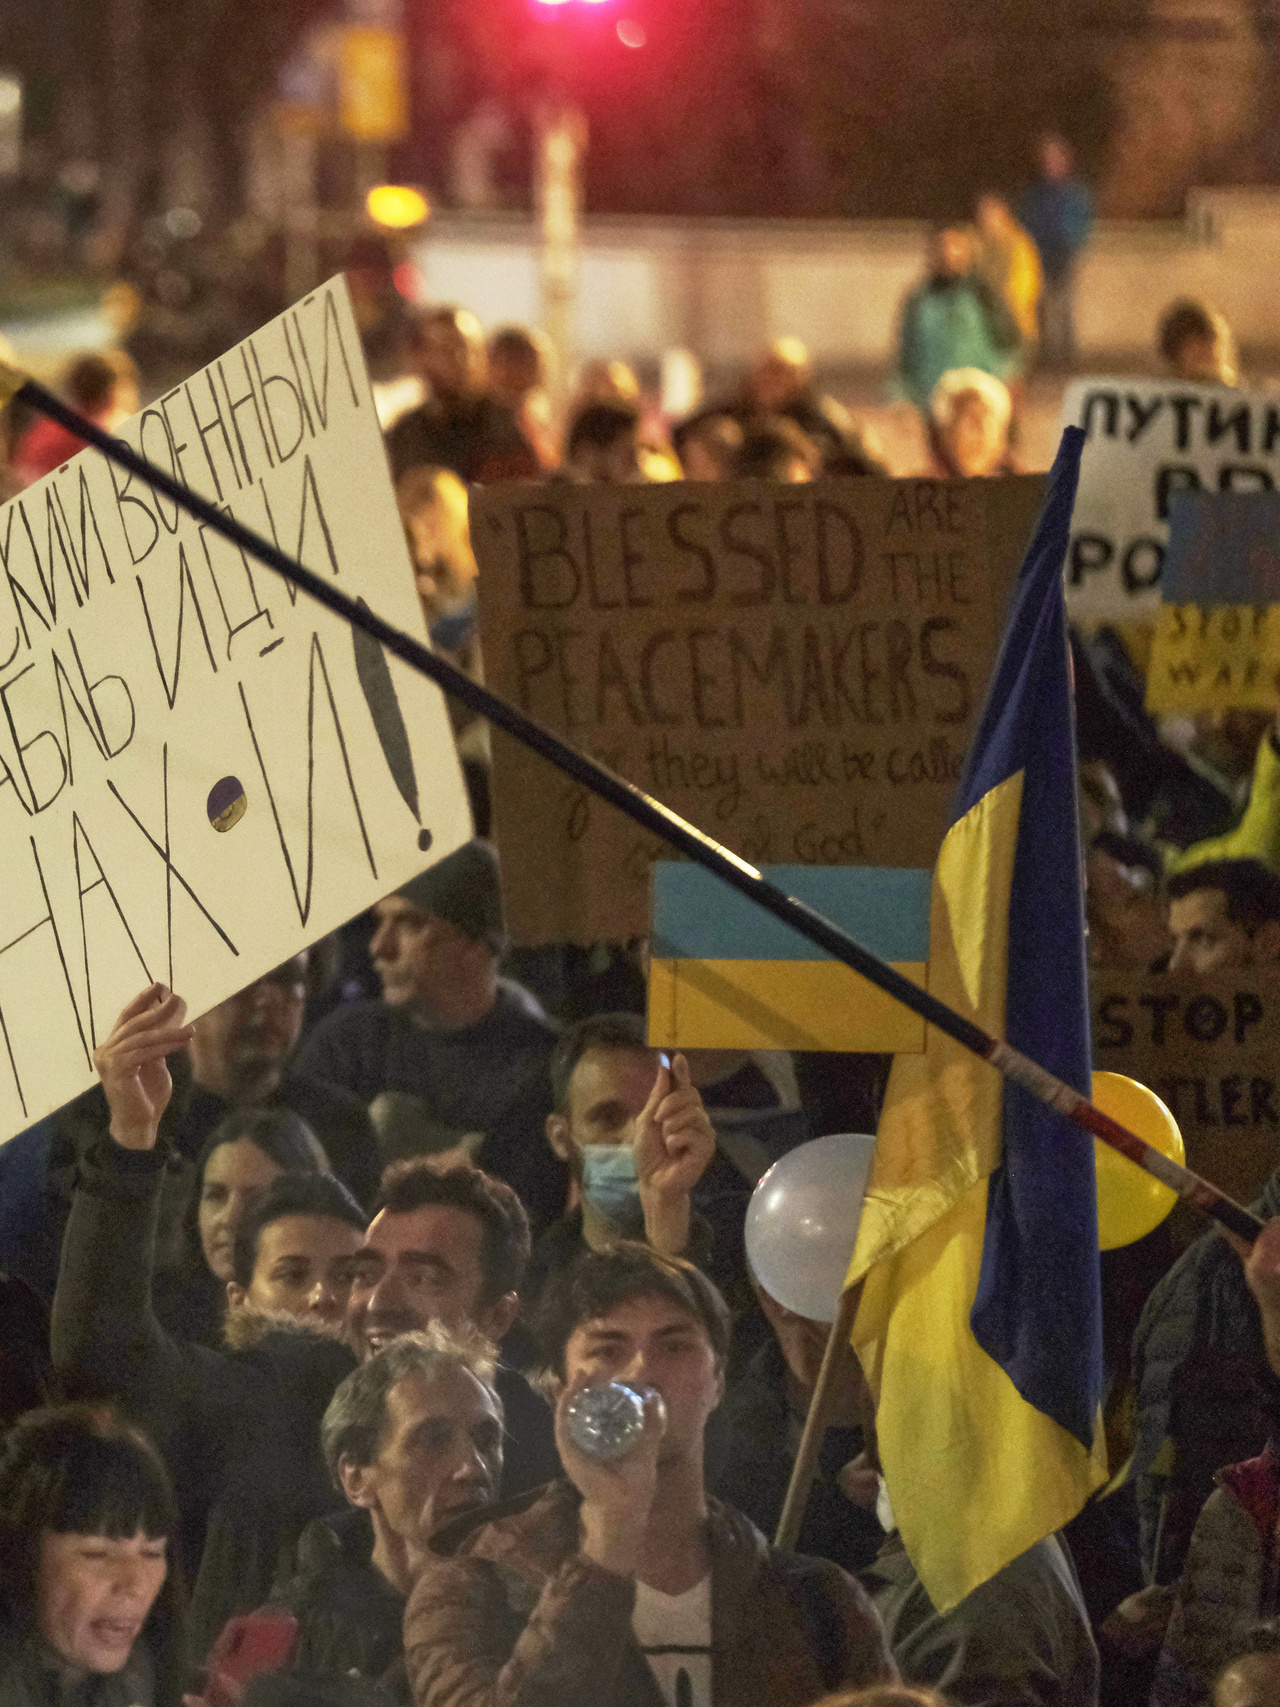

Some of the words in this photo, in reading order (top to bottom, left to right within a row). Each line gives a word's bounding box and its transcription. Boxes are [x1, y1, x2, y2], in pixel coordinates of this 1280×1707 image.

[104, 289, 359, 565] ВОЕННЫЙ
[886, 483, 970, 534] ARE
[136, 454, 340, 710] ИДИ
[880, 551, 972, 606] THE
[512, 615, 973, 728] PEACEMAKERS
[647, 736, 745, 820] they
[756, 741, 832, 786] will
[843, 743, 876, 781] be
[1098, 990, 1265, 1048] STOP
[1158, 1072, 1279, 1126] TLER
